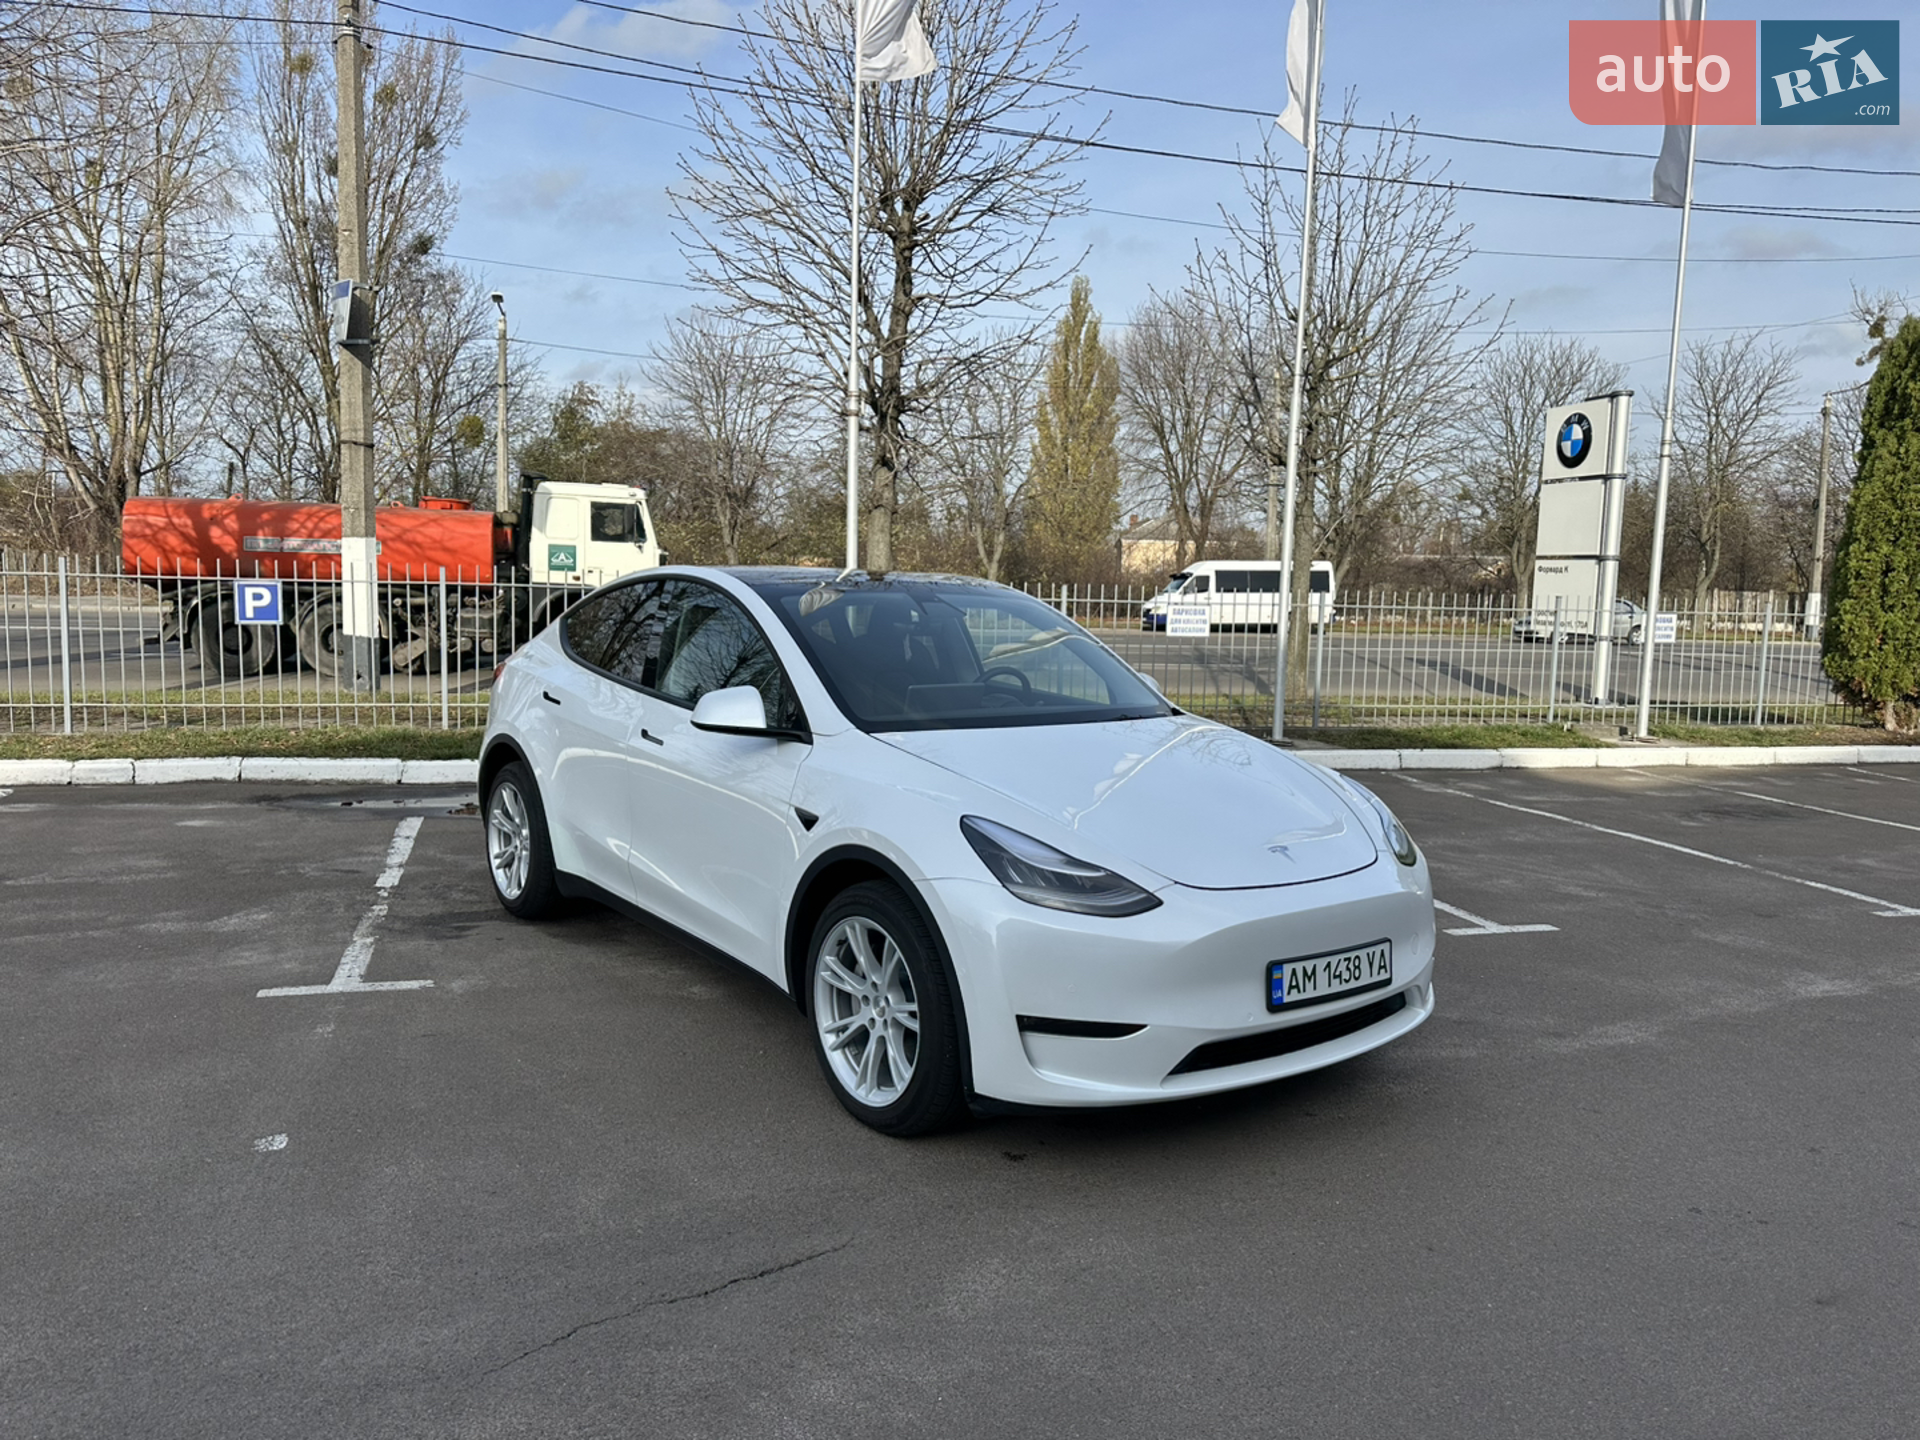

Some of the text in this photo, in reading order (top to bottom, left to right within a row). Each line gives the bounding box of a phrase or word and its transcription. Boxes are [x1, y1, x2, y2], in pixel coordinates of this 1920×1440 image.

[1537, 565, 1563, 574] Форвард
[244, 586, 272, 619] P
[1172, 608, 1206, 616] ПАРКОВКА
[1287, 948, 1388, 996] AM 1438 YA
[1271, 988, 1283, 999] UA
